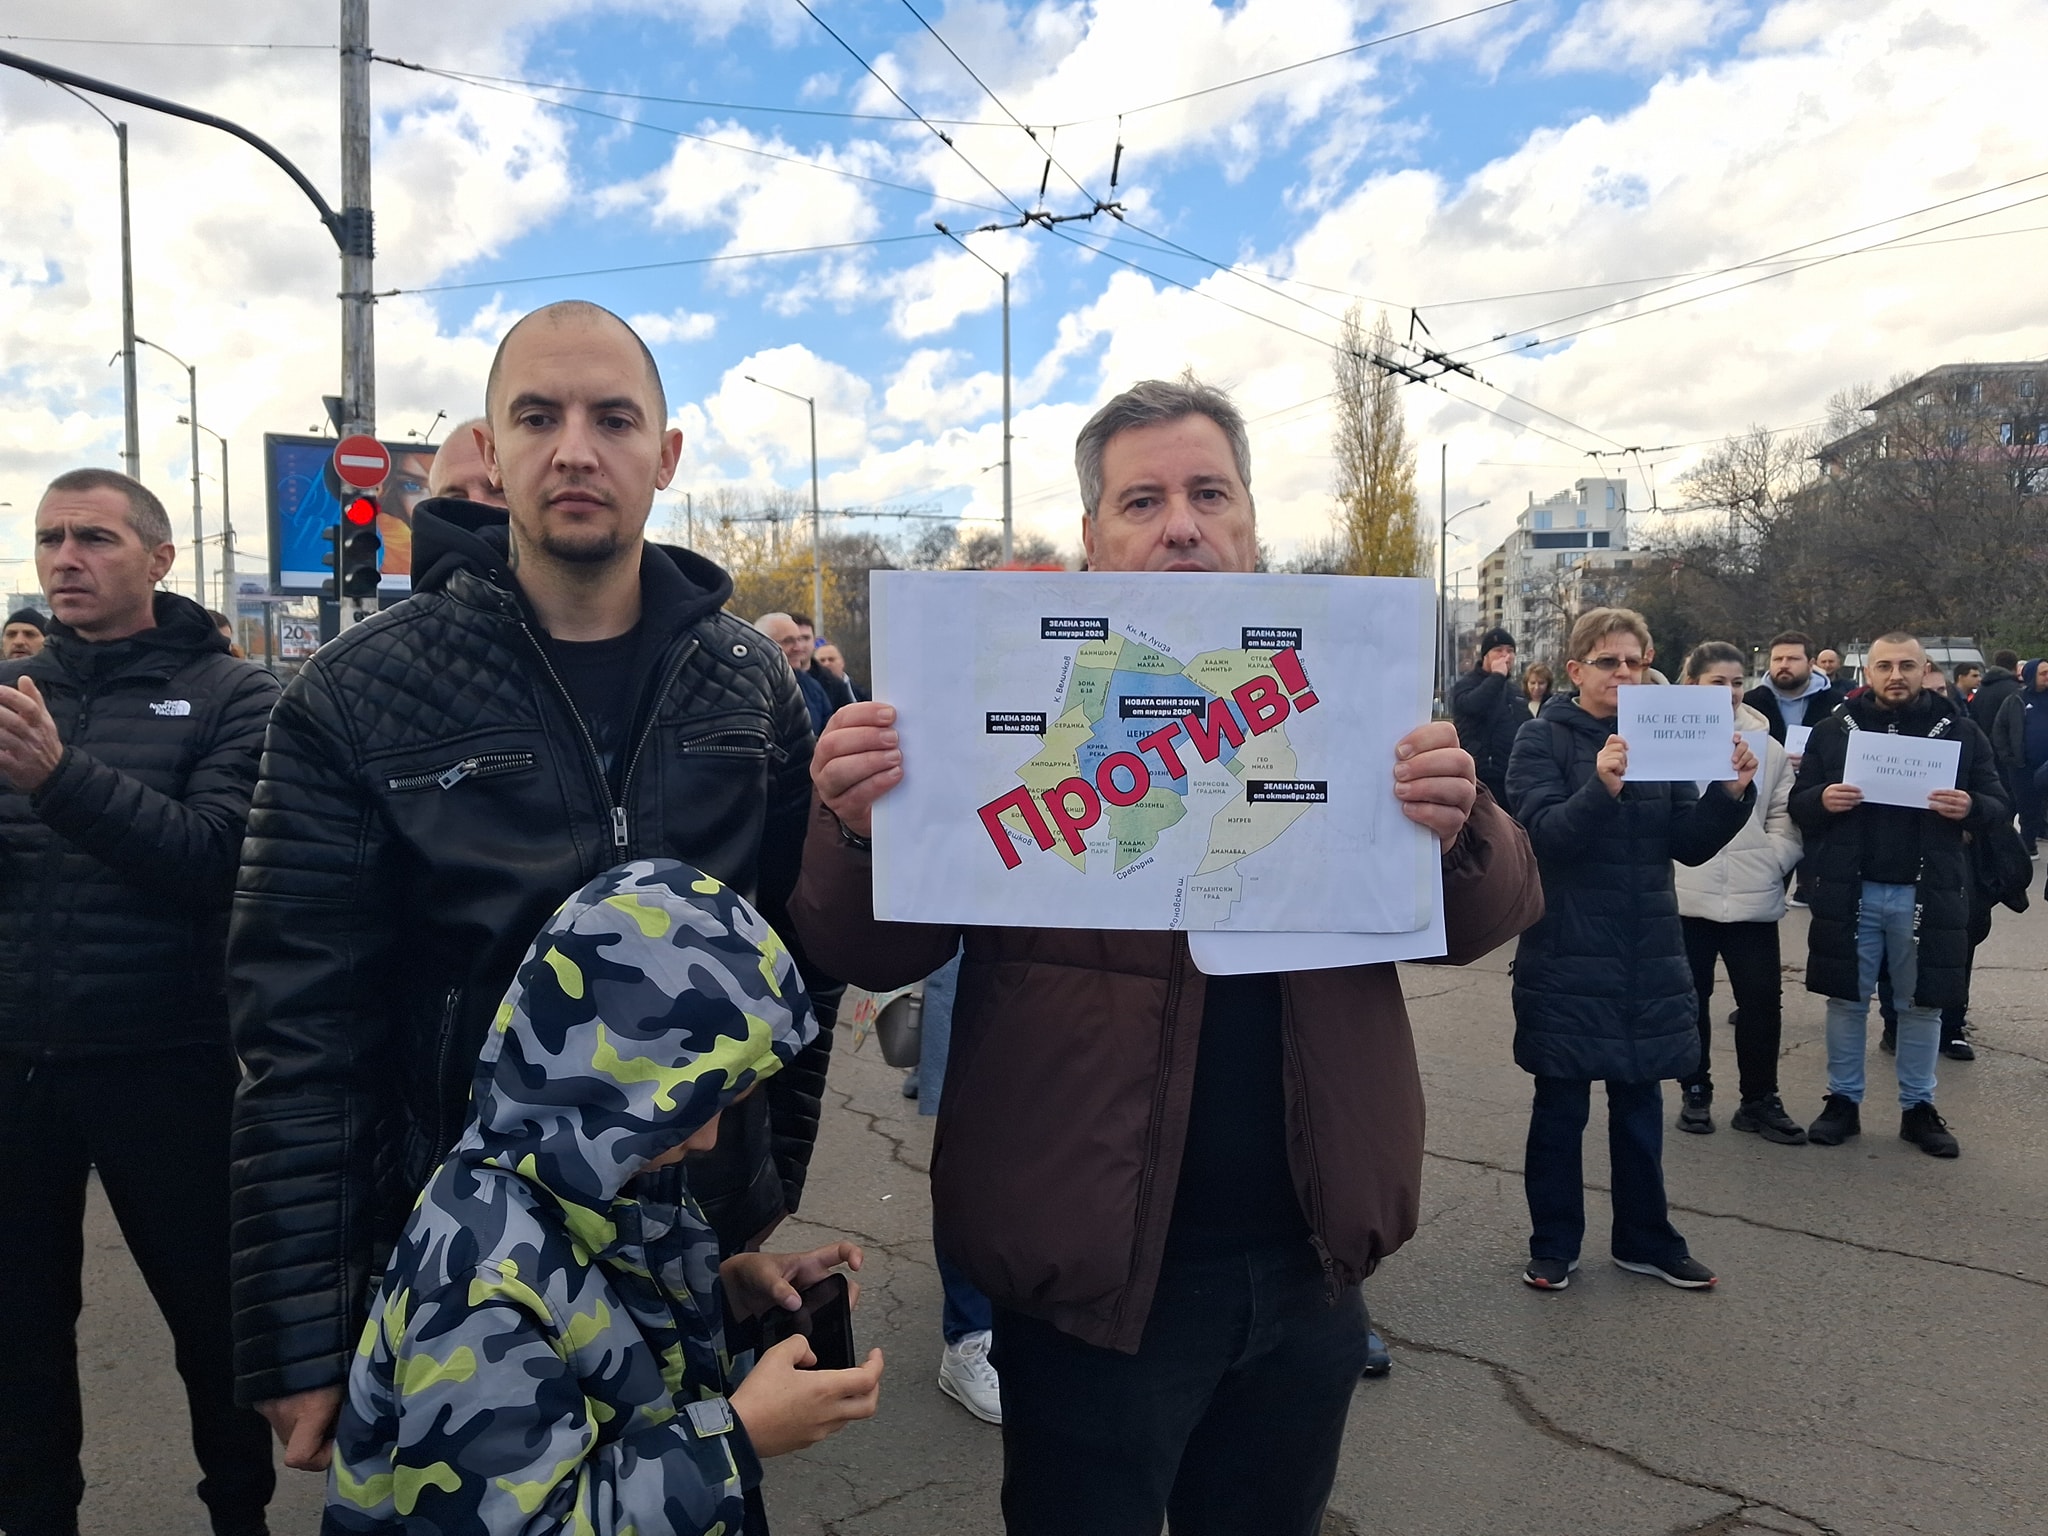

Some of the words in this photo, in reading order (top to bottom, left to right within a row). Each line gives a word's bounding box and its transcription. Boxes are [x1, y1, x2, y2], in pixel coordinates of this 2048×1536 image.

[1048, 620, 1078, 628] ЗЕЛЕНА
[1079, 620, 1101, 628] ЗОНА
[1057, 630, 1084, 638] януари
[1126, 624, 1138, 635] Кн.
[1148, 635, 1172, 653] Луиза
[1246, 630, 1275, 638] ЗЕЛЕНА
[1276, 630, 1298, 638] ЗОНА
[1056, 655, 1072, 693] Величков
[1054, 693, 1061, 703] К.
[1144, 708, 1172, 717] януари
[1637, 714, 1659, 724] НАС
[1663, 714, 1678, 724] НЕ
[1681, 714, 1701, 724] СТЕ
[1705, 714, 1720, 724] НИ
[1653, 730, 1695, 739] ПИТАЛИ
[977, 646, 1320, 871] Против!
[1862, 753, 1882, 762] НАС
[1886, 755, 1898, 764] НЕ
[1904, 758, 1922, 767] СТЕ
[1927, 760, 1942, 769] НИ
[1876, 766, 1917, 778] ПИТАЛИ
[1266, 793, 1305, 801] октомври
[1116, 856, 1155, 881] Сребърна
